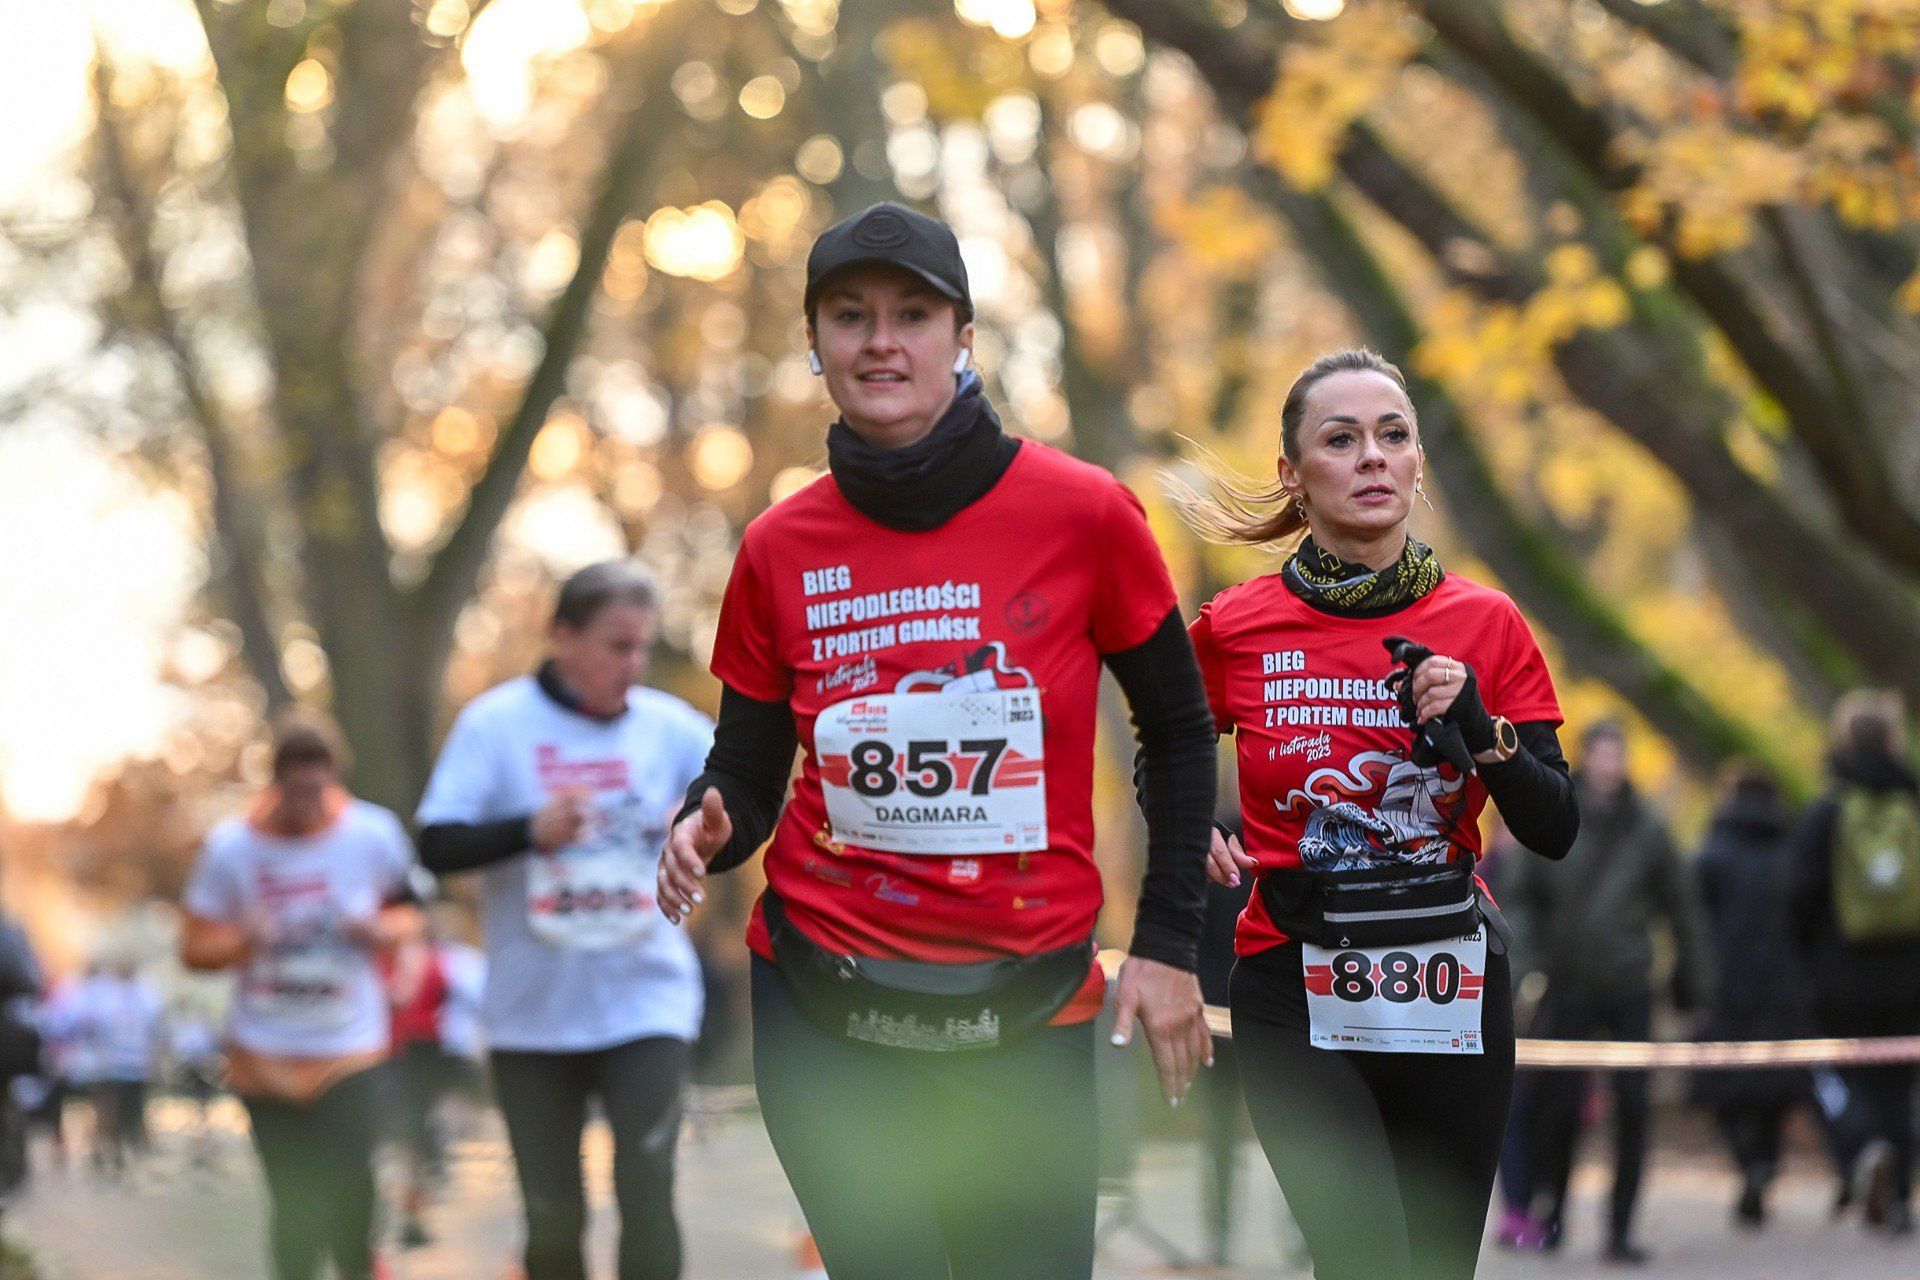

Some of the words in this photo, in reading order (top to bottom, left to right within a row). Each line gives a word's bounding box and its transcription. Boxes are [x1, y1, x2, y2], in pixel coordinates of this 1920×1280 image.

[802, 565, 851, 596] BIEG
[806, 580, 981, 631] NIEPODLEGŁOŚCI
[812, 638, 823, 661] Z
[825, 624, 896, 659] PORTEM
[898, 614, 981, 644] GDAŃSK
[1262, 650, 1305, 675] BIEG
[1265, 708, 1274, 727] Z
[1277, 705, 1347, 727] PORTEM
[1268, 746, 1275, 761] 11
[1280, 729, 1331, 756] listopada
[1306, 744, 1331, 763] 2023
[851, 738, 1007, 797] 857
[875, 806, 987, 823] DAGMARA
[1332, 951, 1460, 1005] 880
